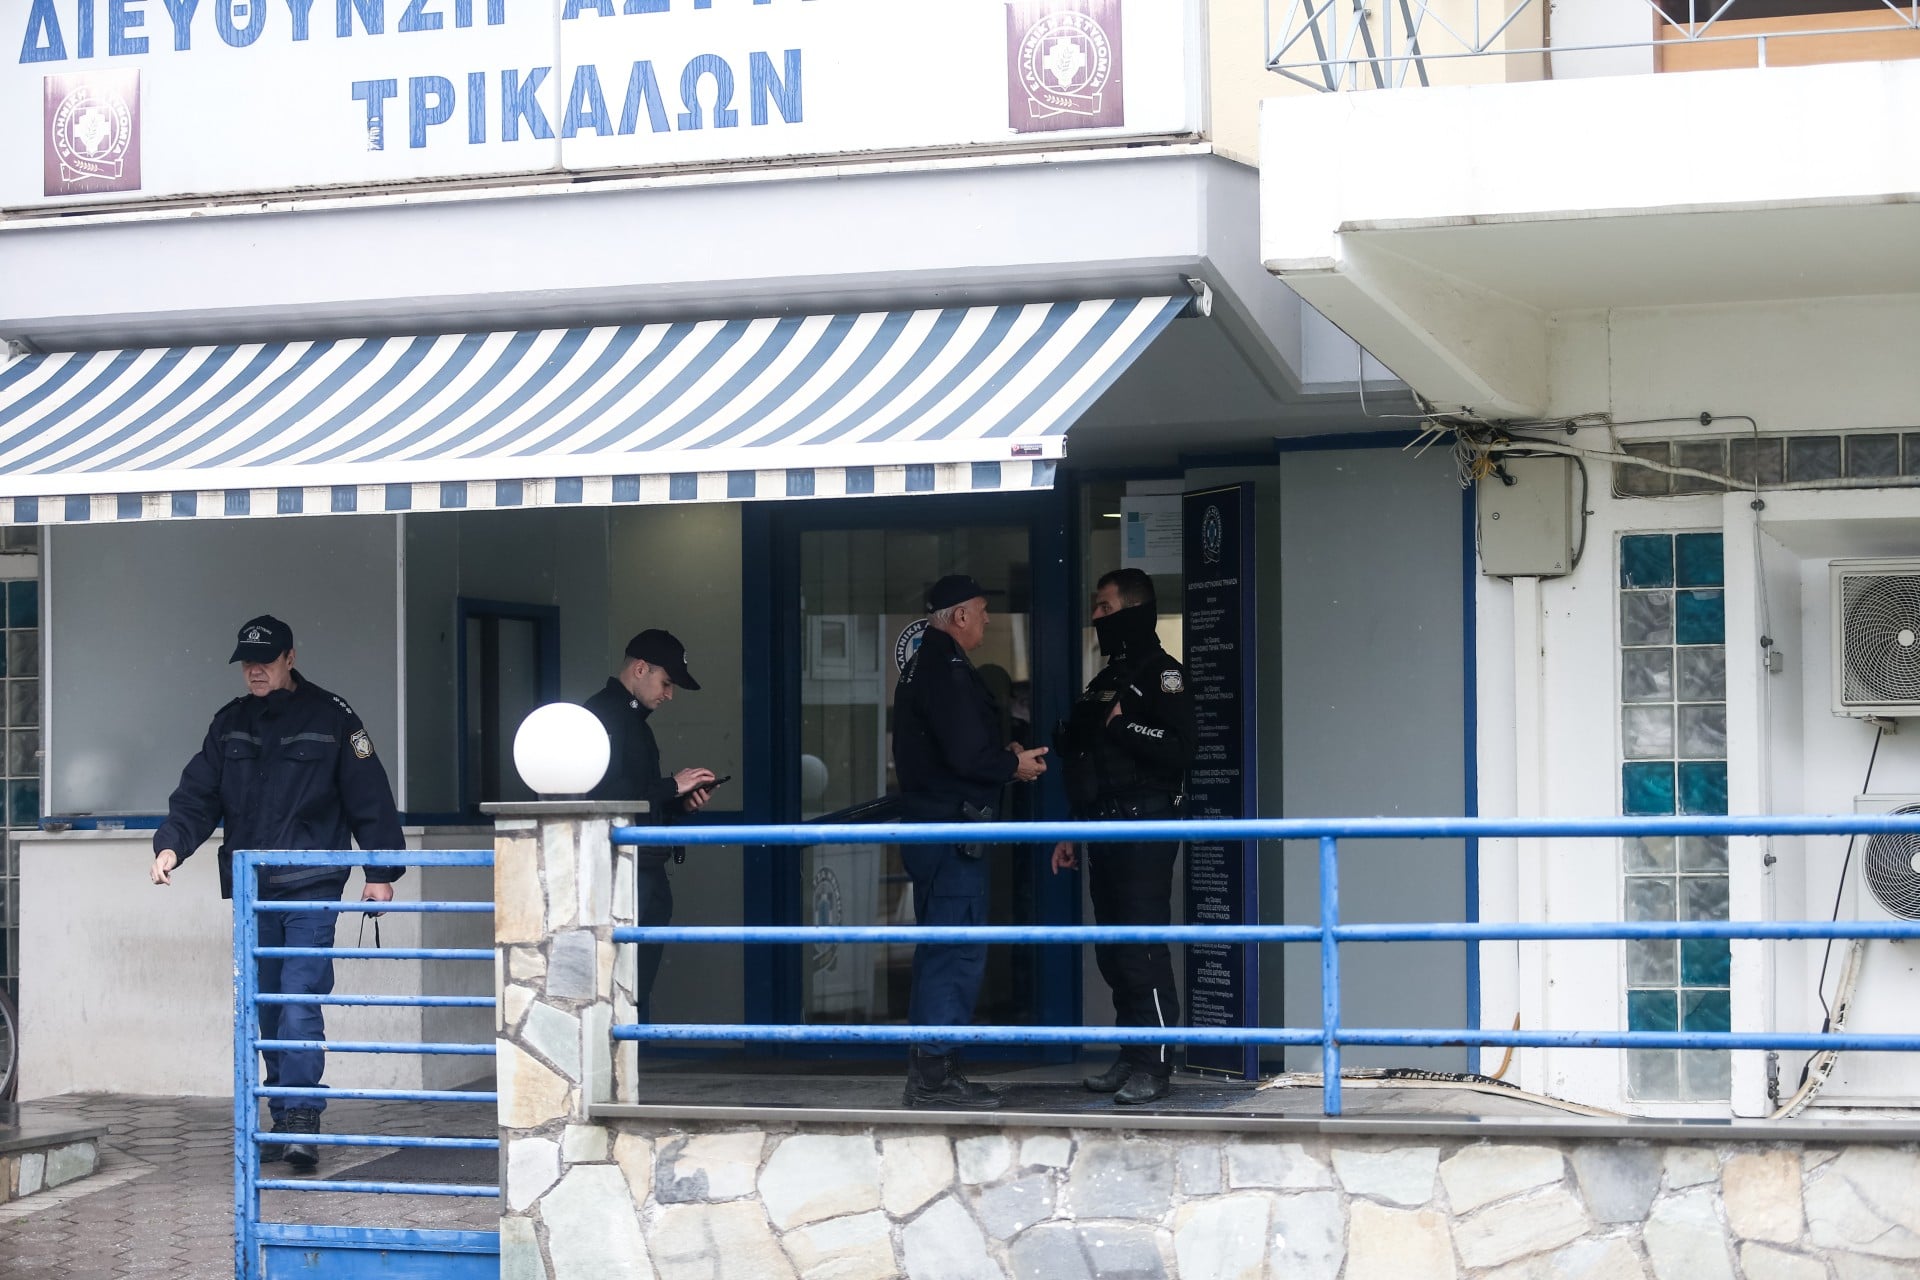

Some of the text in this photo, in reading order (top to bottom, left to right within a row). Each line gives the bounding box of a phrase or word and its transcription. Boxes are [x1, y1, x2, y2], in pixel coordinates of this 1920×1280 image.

[352, 48, 803, 151] ΤΡΙΚΑΛΩΝ
[897, 623, 921, 669] ΛΛΗΝΙΚΗ
[1127, 722, 1165, 738] POLICE
